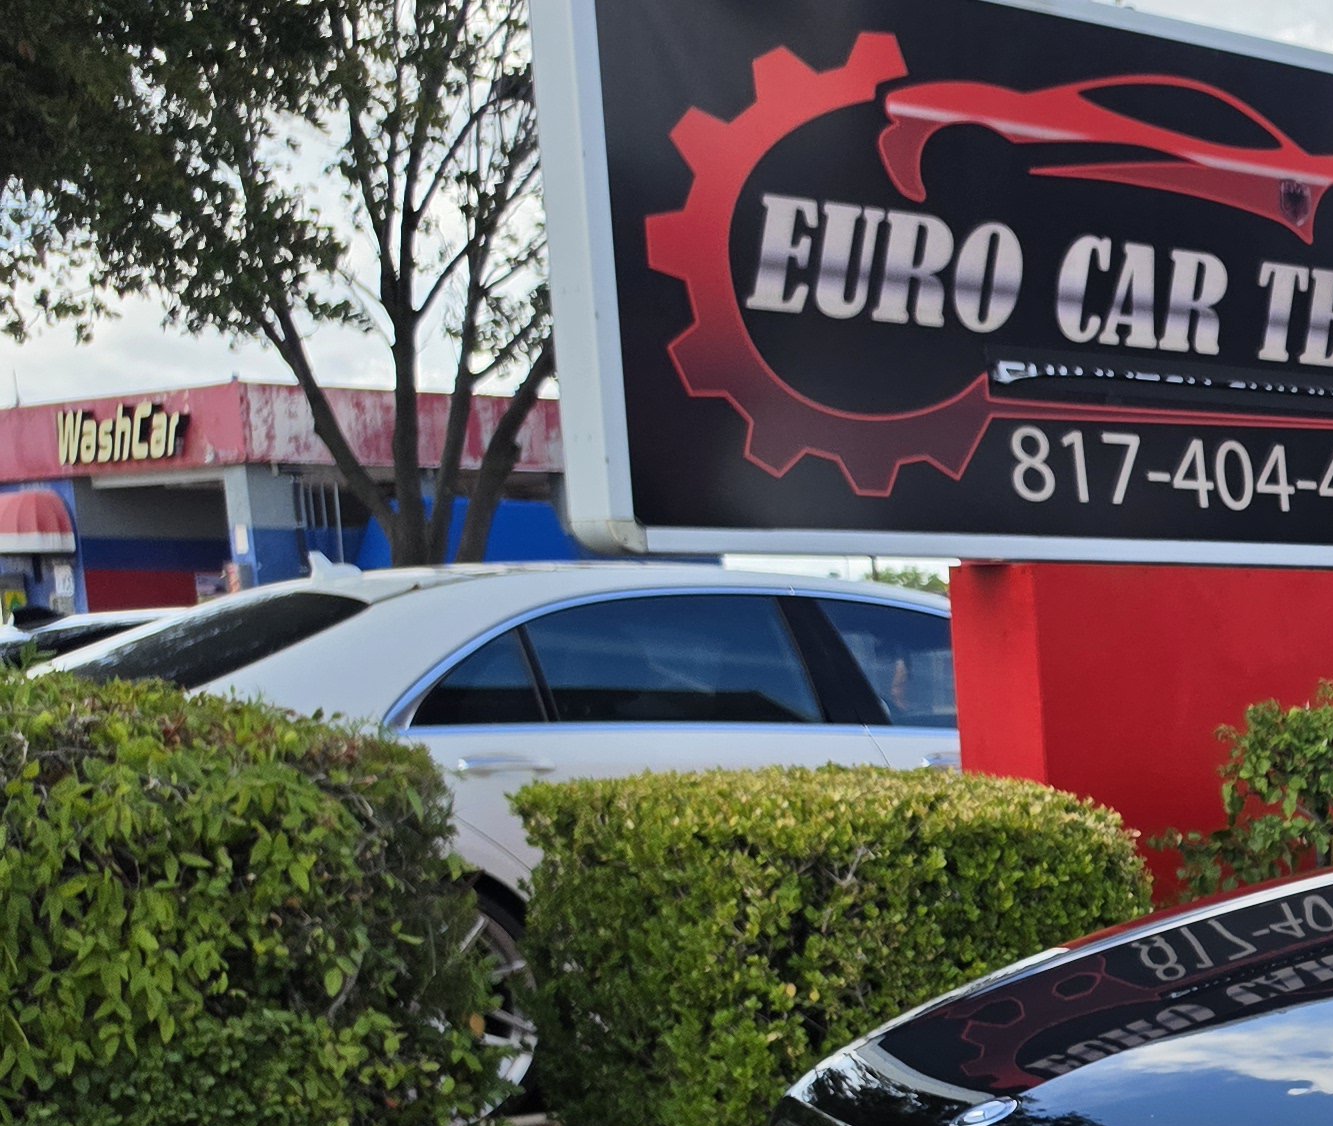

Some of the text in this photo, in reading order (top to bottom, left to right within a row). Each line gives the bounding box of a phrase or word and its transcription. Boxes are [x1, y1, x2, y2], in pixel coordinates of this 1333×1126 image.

[746, 193, 1023, 333] EURO
[1055, 234, 1228, 355] CAR
[57, 401, 180, 466] WashCar
